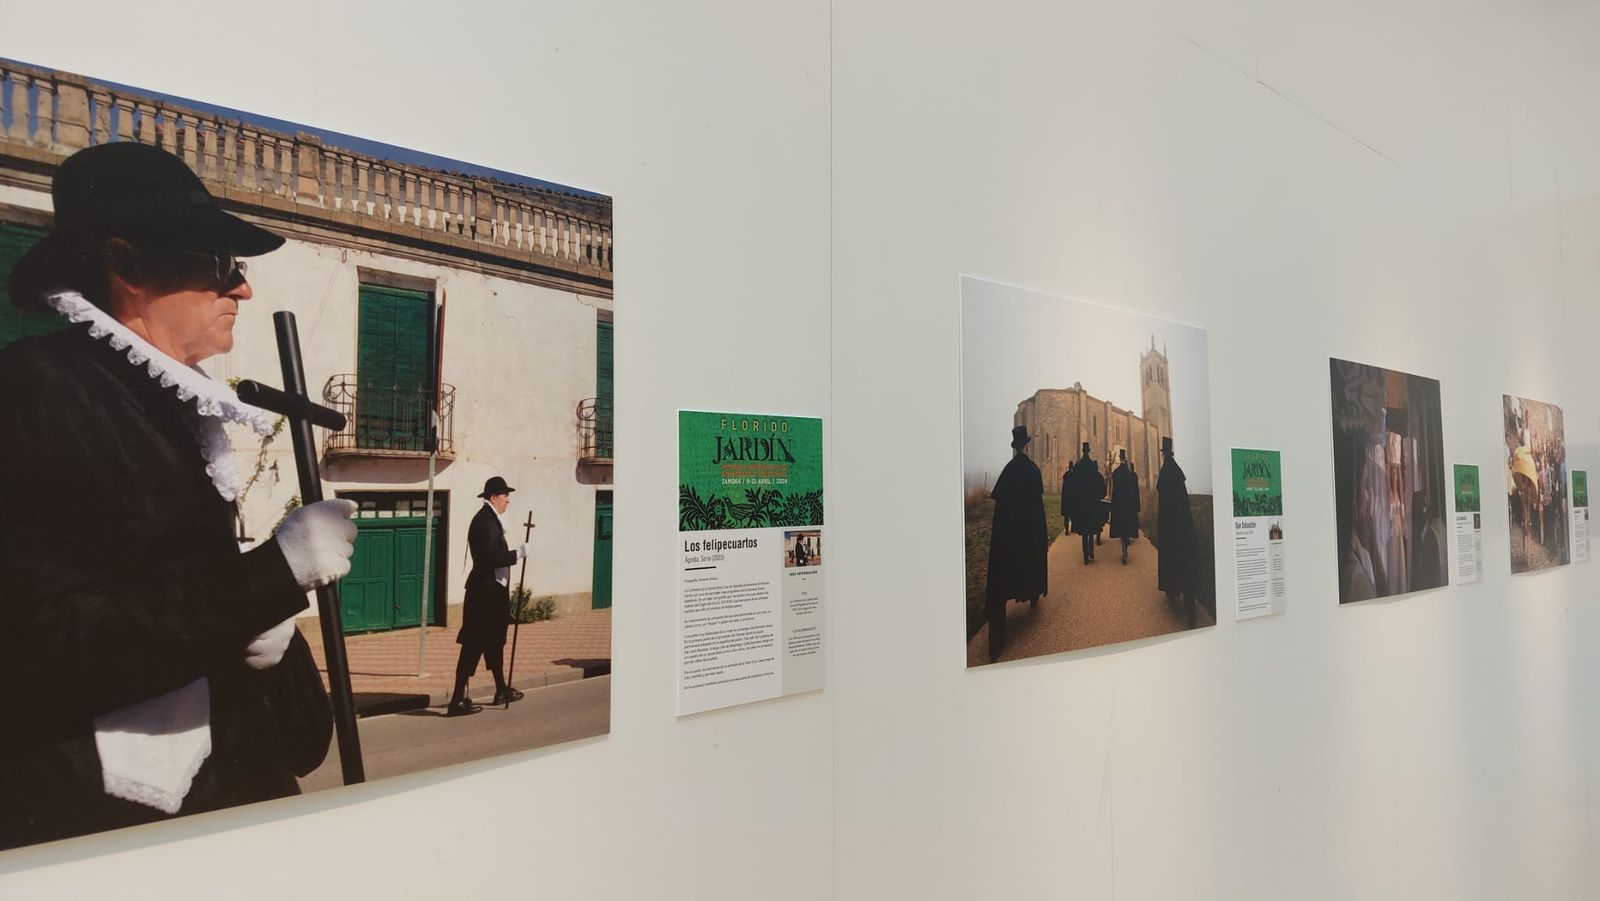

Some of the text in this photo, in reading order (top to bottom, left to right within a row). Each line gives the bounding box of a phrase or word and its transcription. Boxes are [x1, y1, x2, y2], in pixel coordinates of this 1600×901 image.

[721, 419, 788, 432] FLORIDO
[712, 433, 797, 464] JARDÍN
[684, 537, 758, 552] Los felipecuartos
